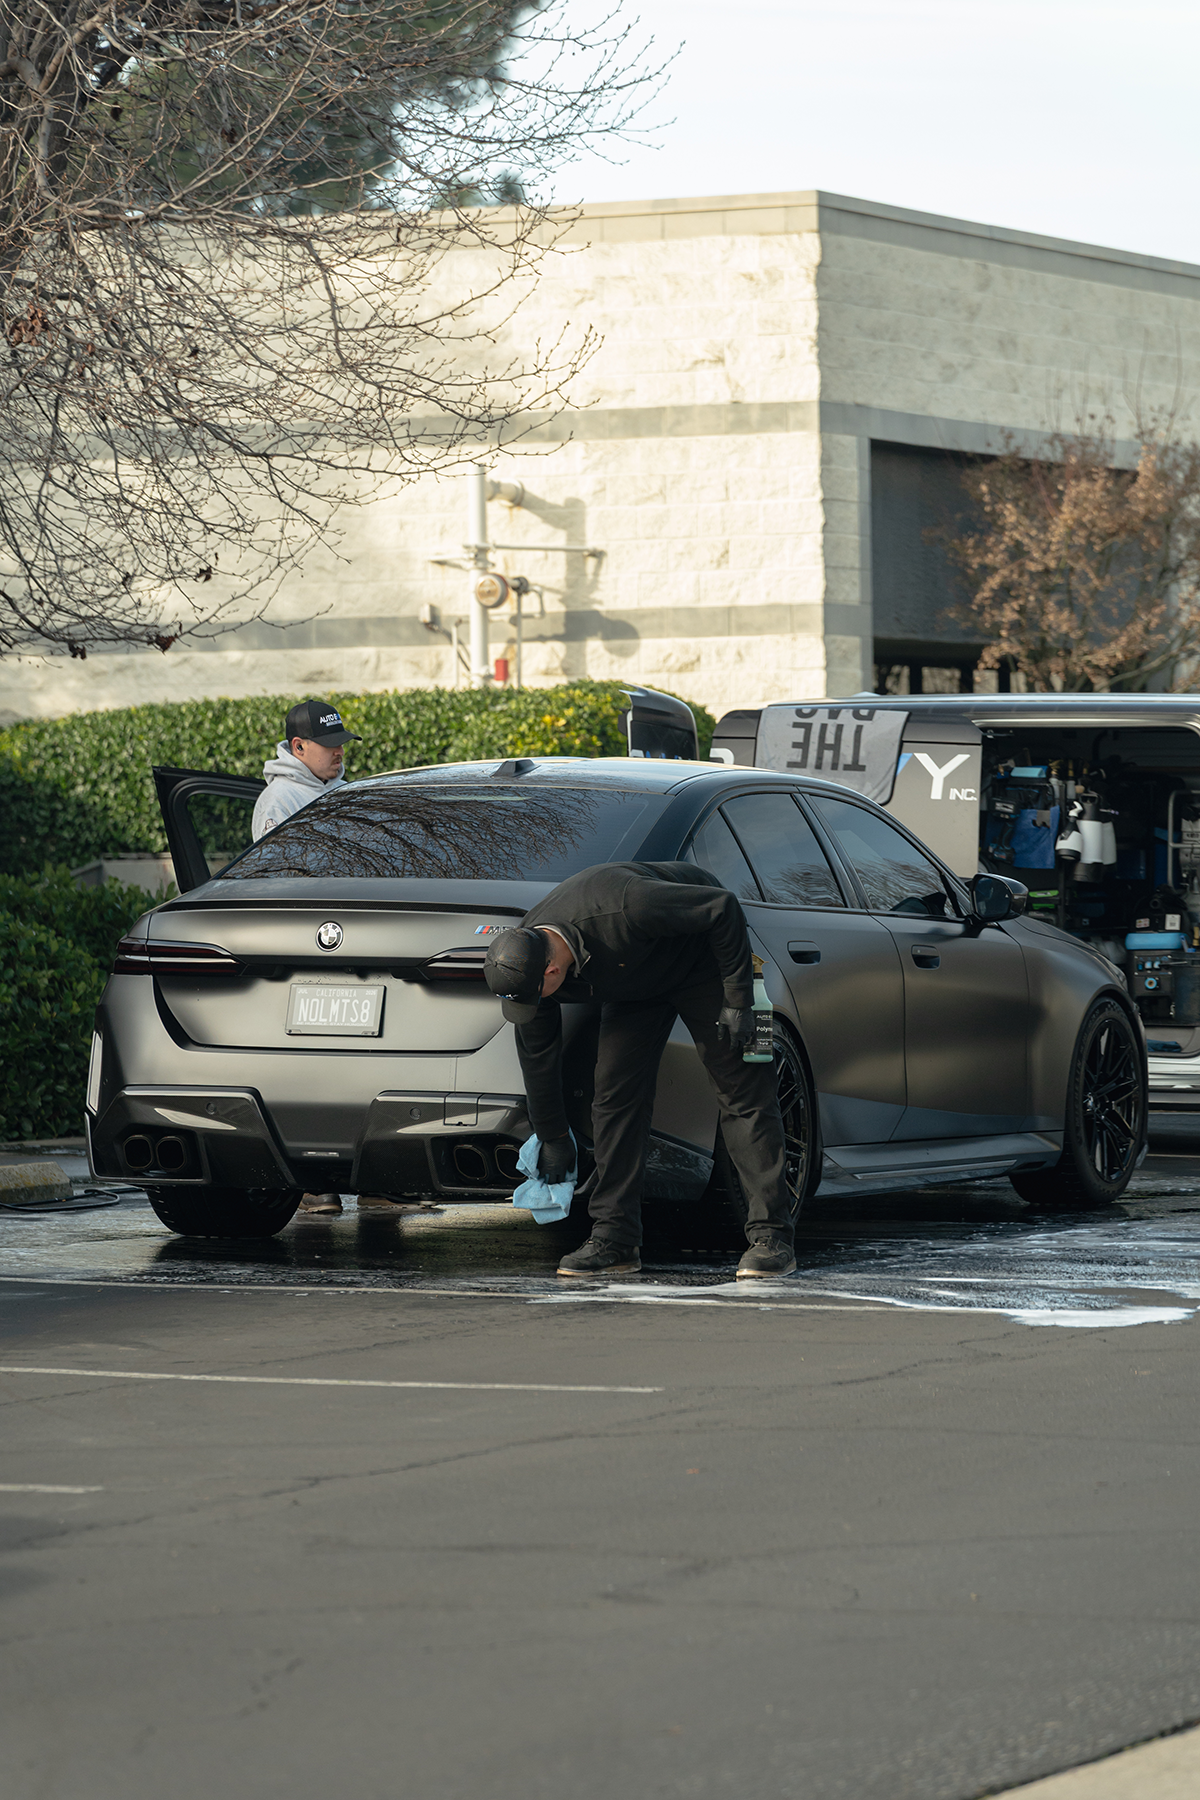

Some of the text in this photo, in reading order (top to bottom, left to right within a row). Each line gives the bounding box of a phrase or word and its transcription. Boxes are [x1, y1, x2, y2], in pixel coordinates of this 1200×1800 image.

[319, 713, 334, 724] AUTO
[786, 721, 866, 772] THE
[316, 988, 357, 998] CALIFORNIA
[298, 998, 371, 1023] NOLMTS8
